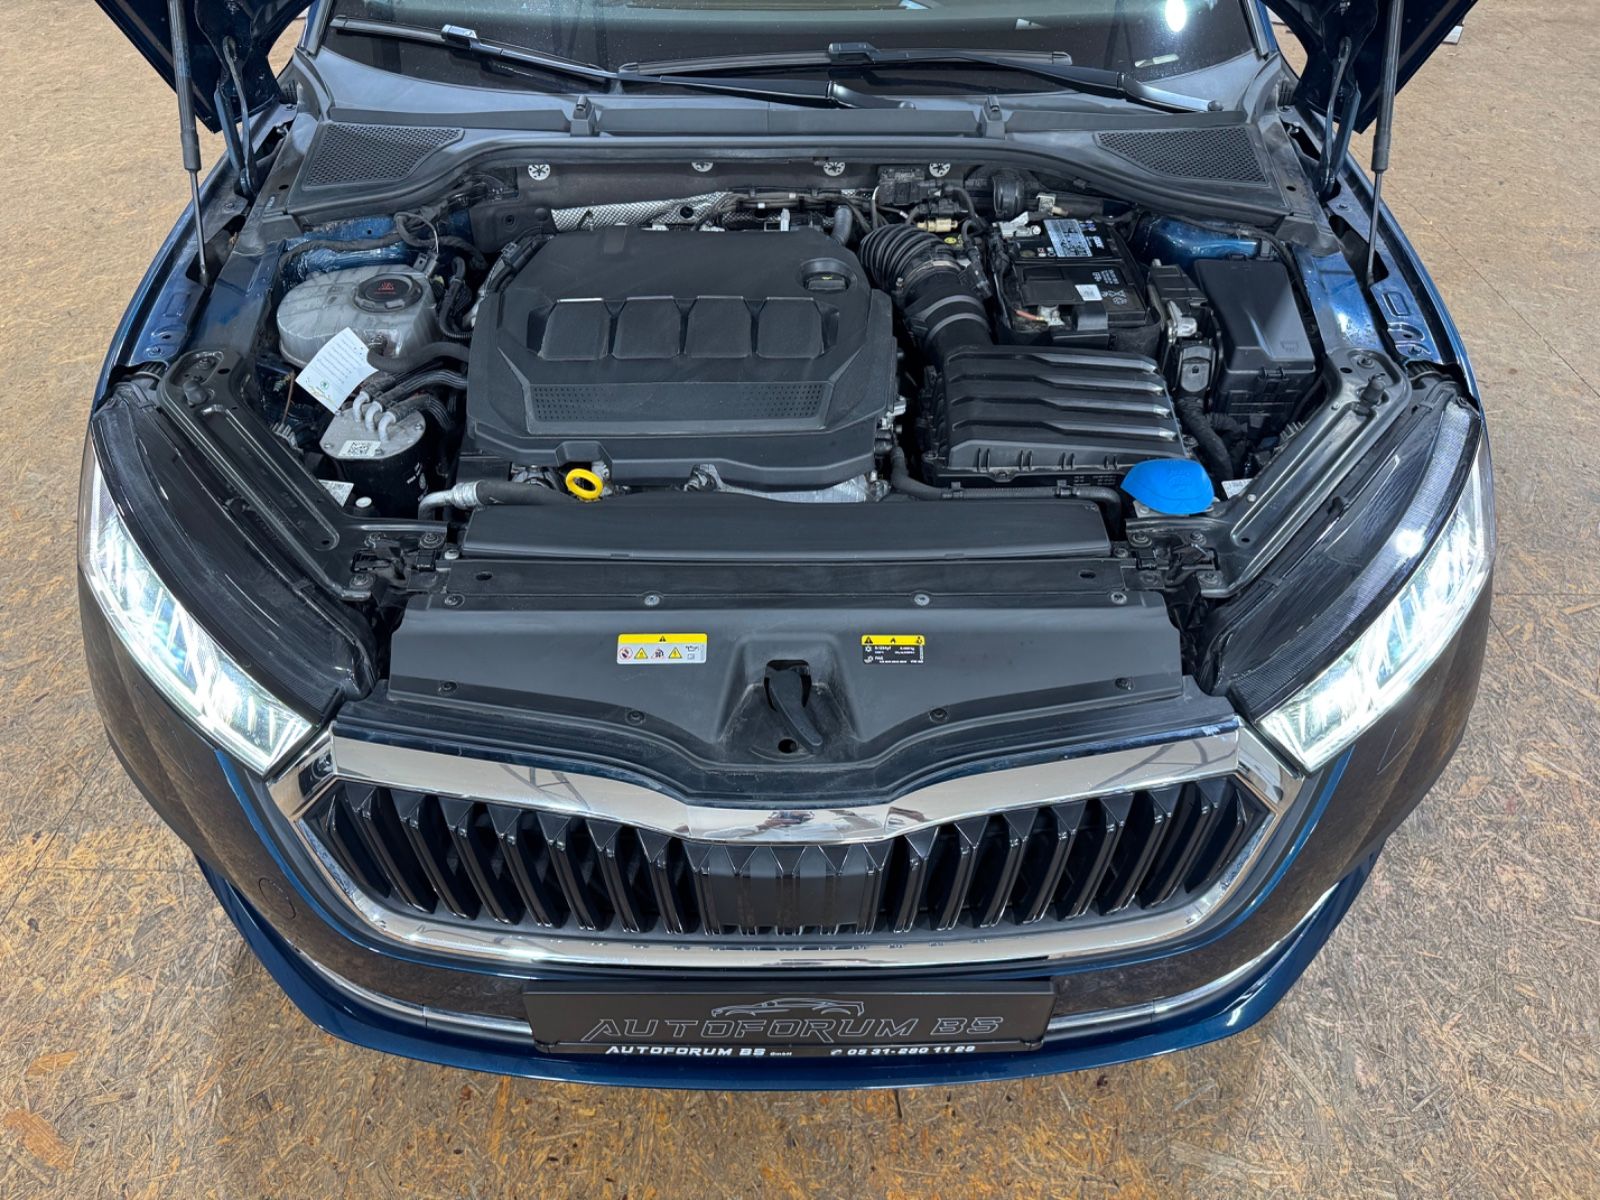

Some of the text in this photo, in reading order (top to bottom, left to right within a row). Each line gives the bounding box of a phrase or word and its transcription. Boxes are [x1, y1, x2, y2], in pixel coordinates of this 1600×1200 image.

[580, 1016, 1004, 1044] AUTOFORUM BS
[605, 1045, 732, 1057] AUTOFORUM
[739, 1047, 766, 1057] BS
[847, 1048, 867, 1056] 05
[933, 1045, 951, 1054] 11
